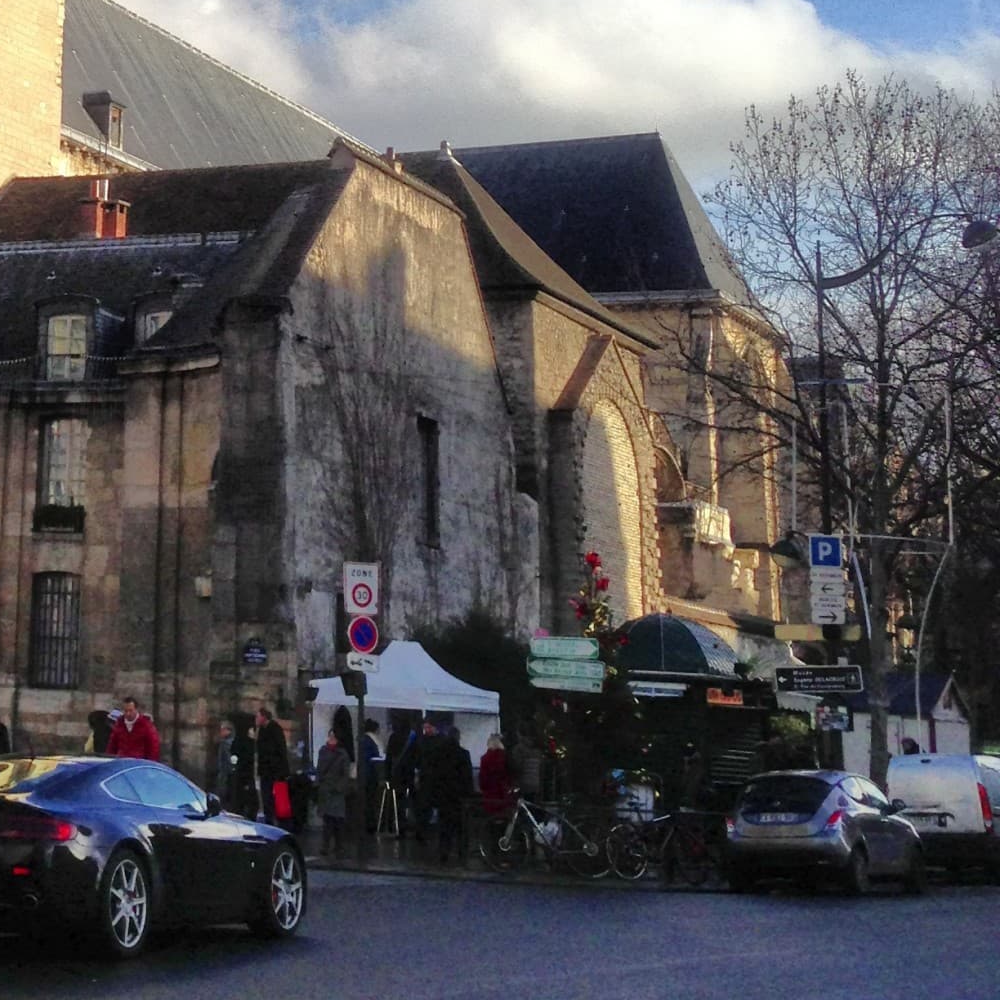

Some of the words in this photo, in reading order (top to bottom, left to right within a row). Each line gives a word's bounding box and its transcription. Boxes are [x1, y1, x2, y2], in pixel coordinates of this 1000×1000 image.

[818, 541, 832, 561] P
[351, 568, 373, 577] ZONE
[356, 591, 368, 600] 30
